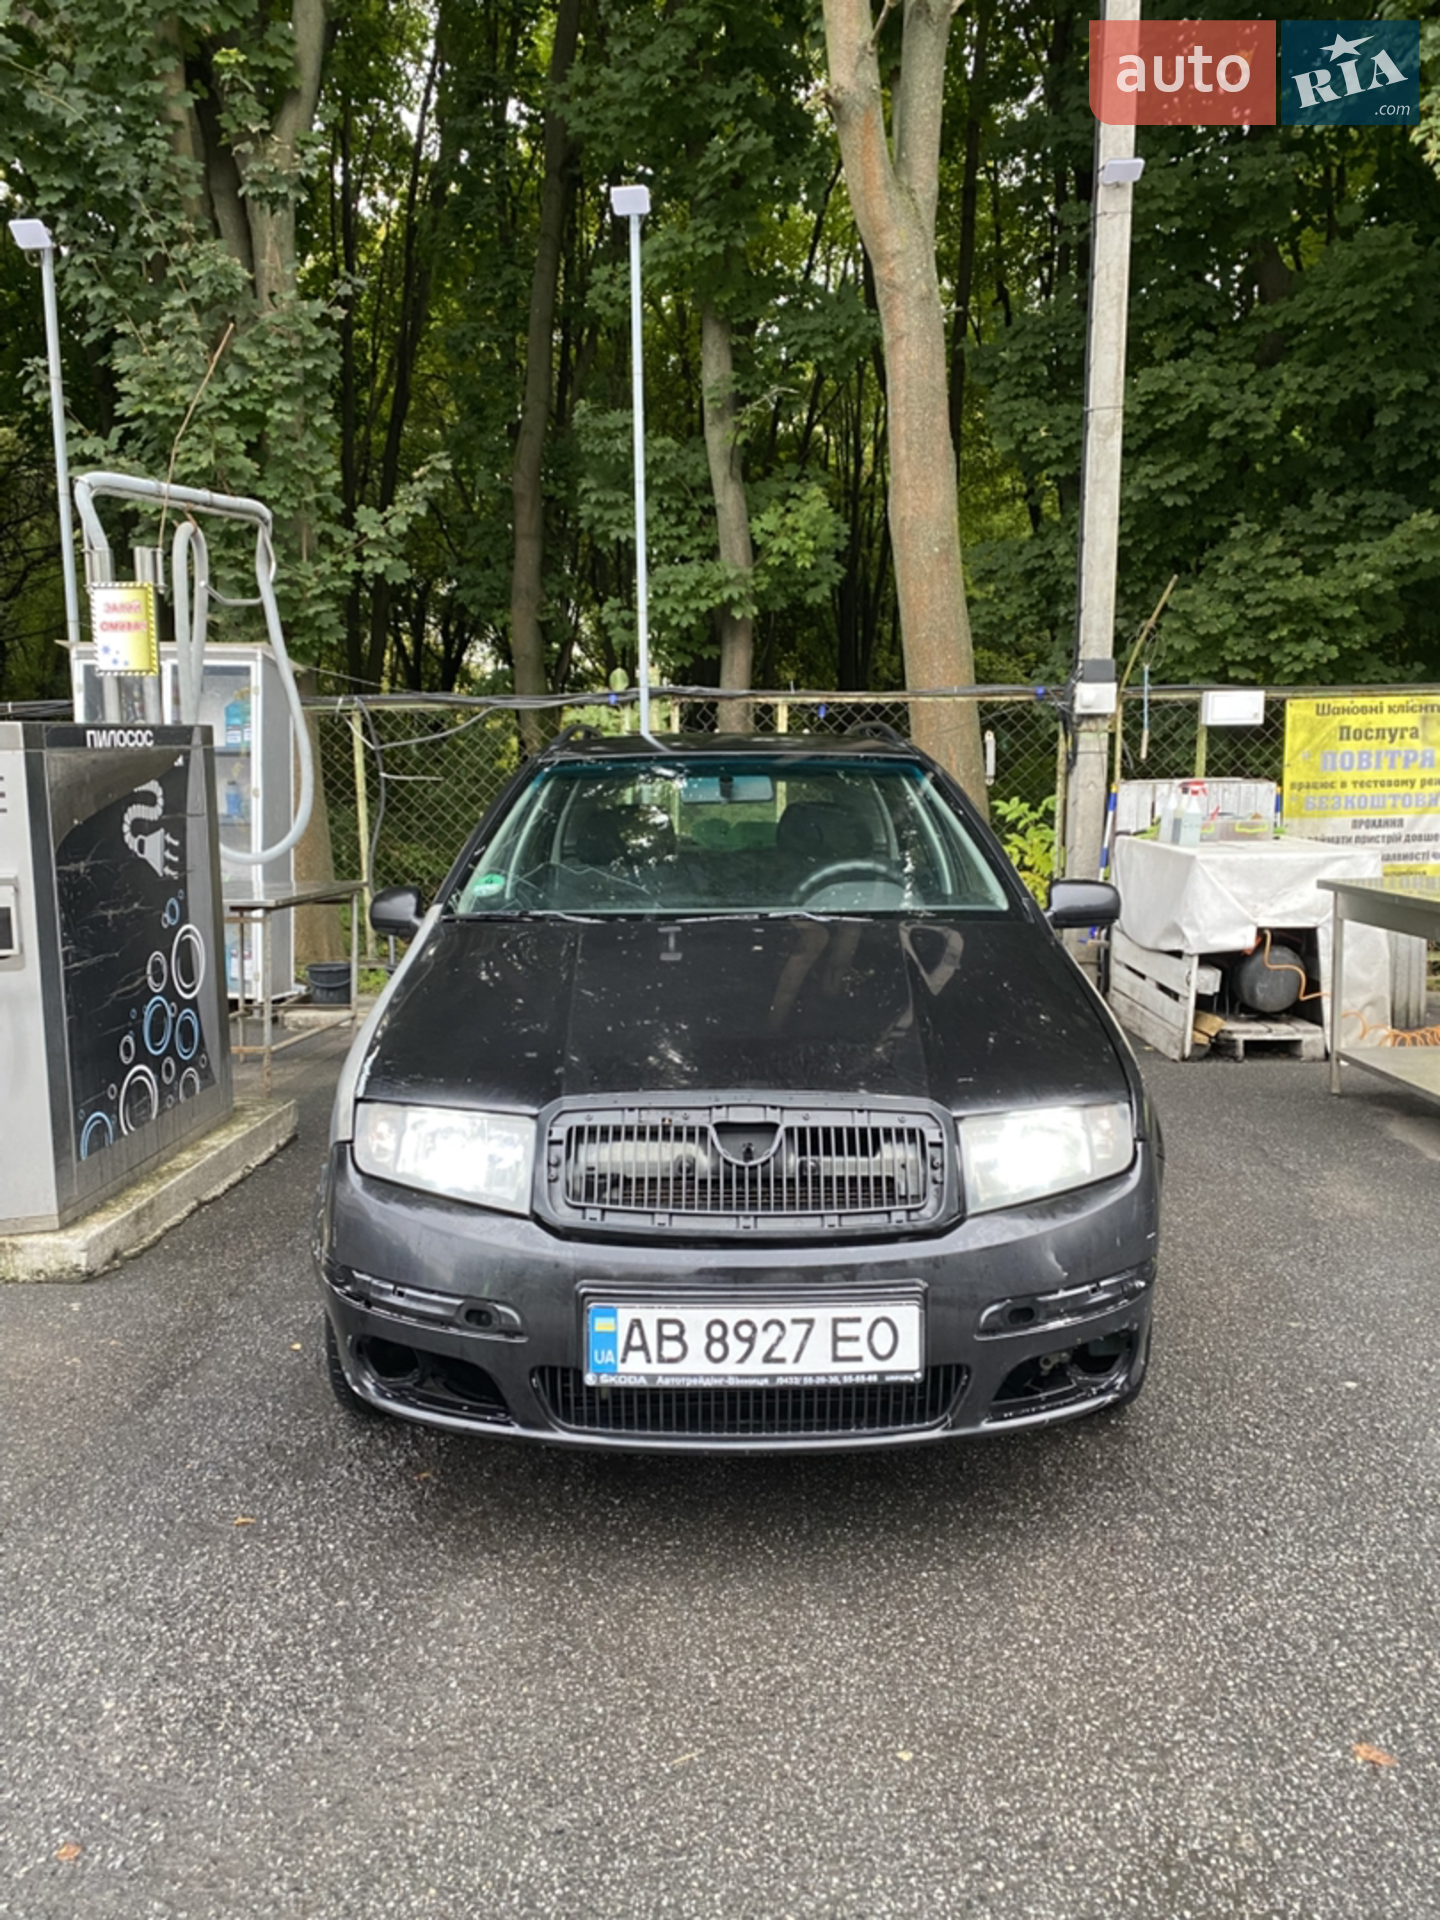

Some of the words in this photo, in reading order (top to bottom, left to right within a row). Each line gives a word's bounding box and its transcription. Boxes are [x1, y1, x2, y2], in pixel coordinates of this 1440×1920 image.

[1315, 701, 1384, 716] Шановні
[1387, 699, 1440, 714] клієнт
[86, 730, 154, 748] ПИЛОСОС
[1339, 725, 1420, 744] Послуга
[1351, 778, 1416, 790] тестовому
[620, 1317, 689, 1365] AB
[704, 1317, 815, 1365] 8927
[831, 1315, 899, 1362] EO
[594, 1350, 616, 1364] UA
